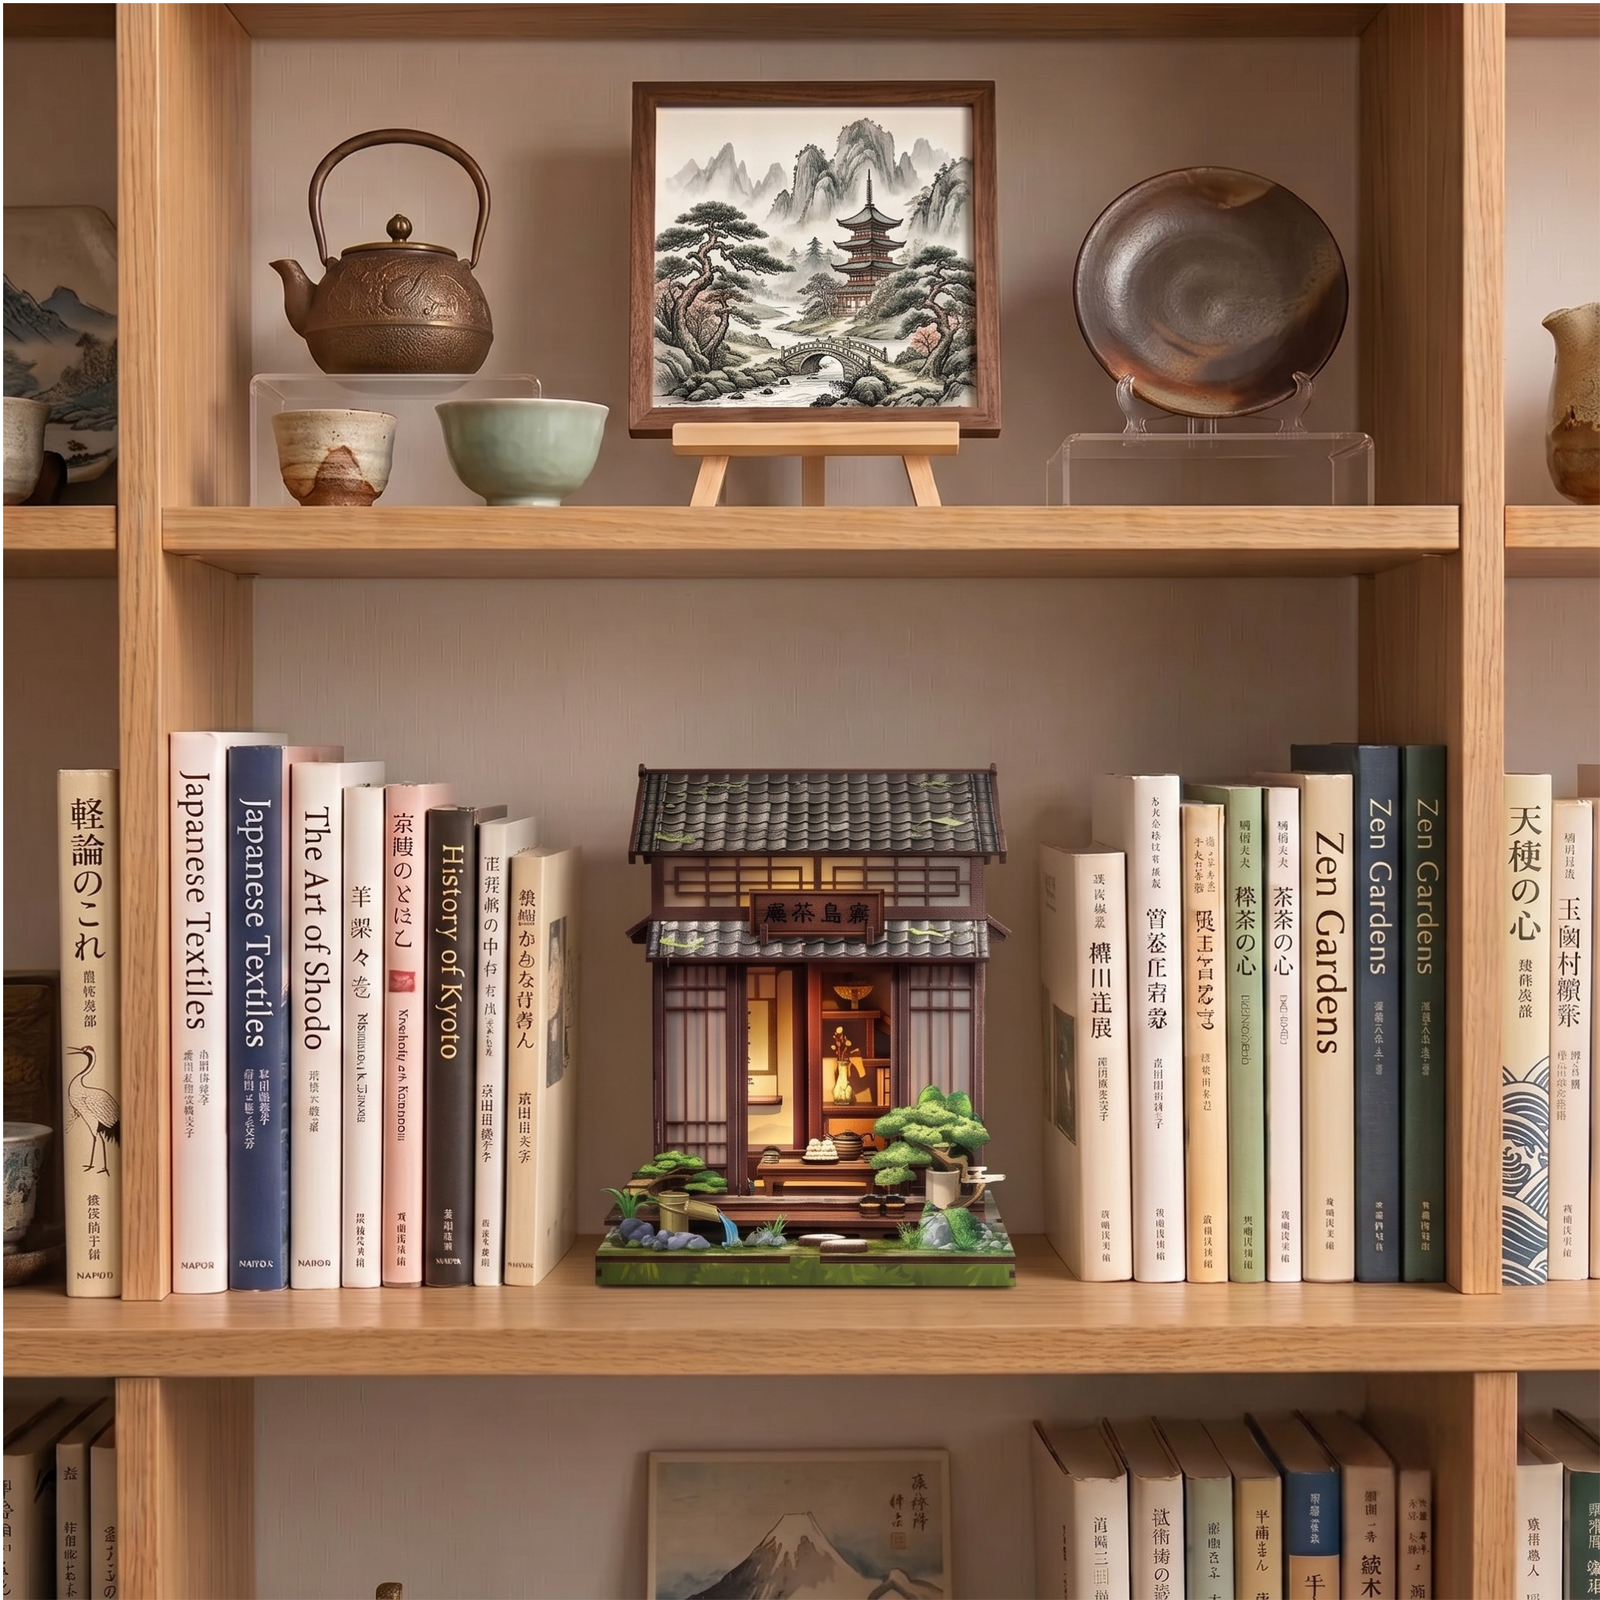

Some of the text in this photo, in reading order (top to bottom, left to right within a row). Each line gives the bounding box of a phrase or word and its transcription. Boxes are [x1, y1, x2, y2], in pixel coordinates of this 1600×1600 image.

[178, 771, 210, 902] Japanese
[237, 798, 271, 927] Japanese
[305, 806, 331, 860] The
[305, 869, 329, 915] Art
[1370, 799, 1392, 974] Zen Gardens
[1417, 799, 1439, 974] Zen Gardens
[186, 912, 213, 1029] Textiles
[246, 935, 273, 1047] Textiles
[305, 925, 331, 955] of
[436, 845, 465, 1059] History of Kyoto
[1316, 831, 1347, 1053] Zen Gardens
[304, 962, 330, 1049] Shodo
